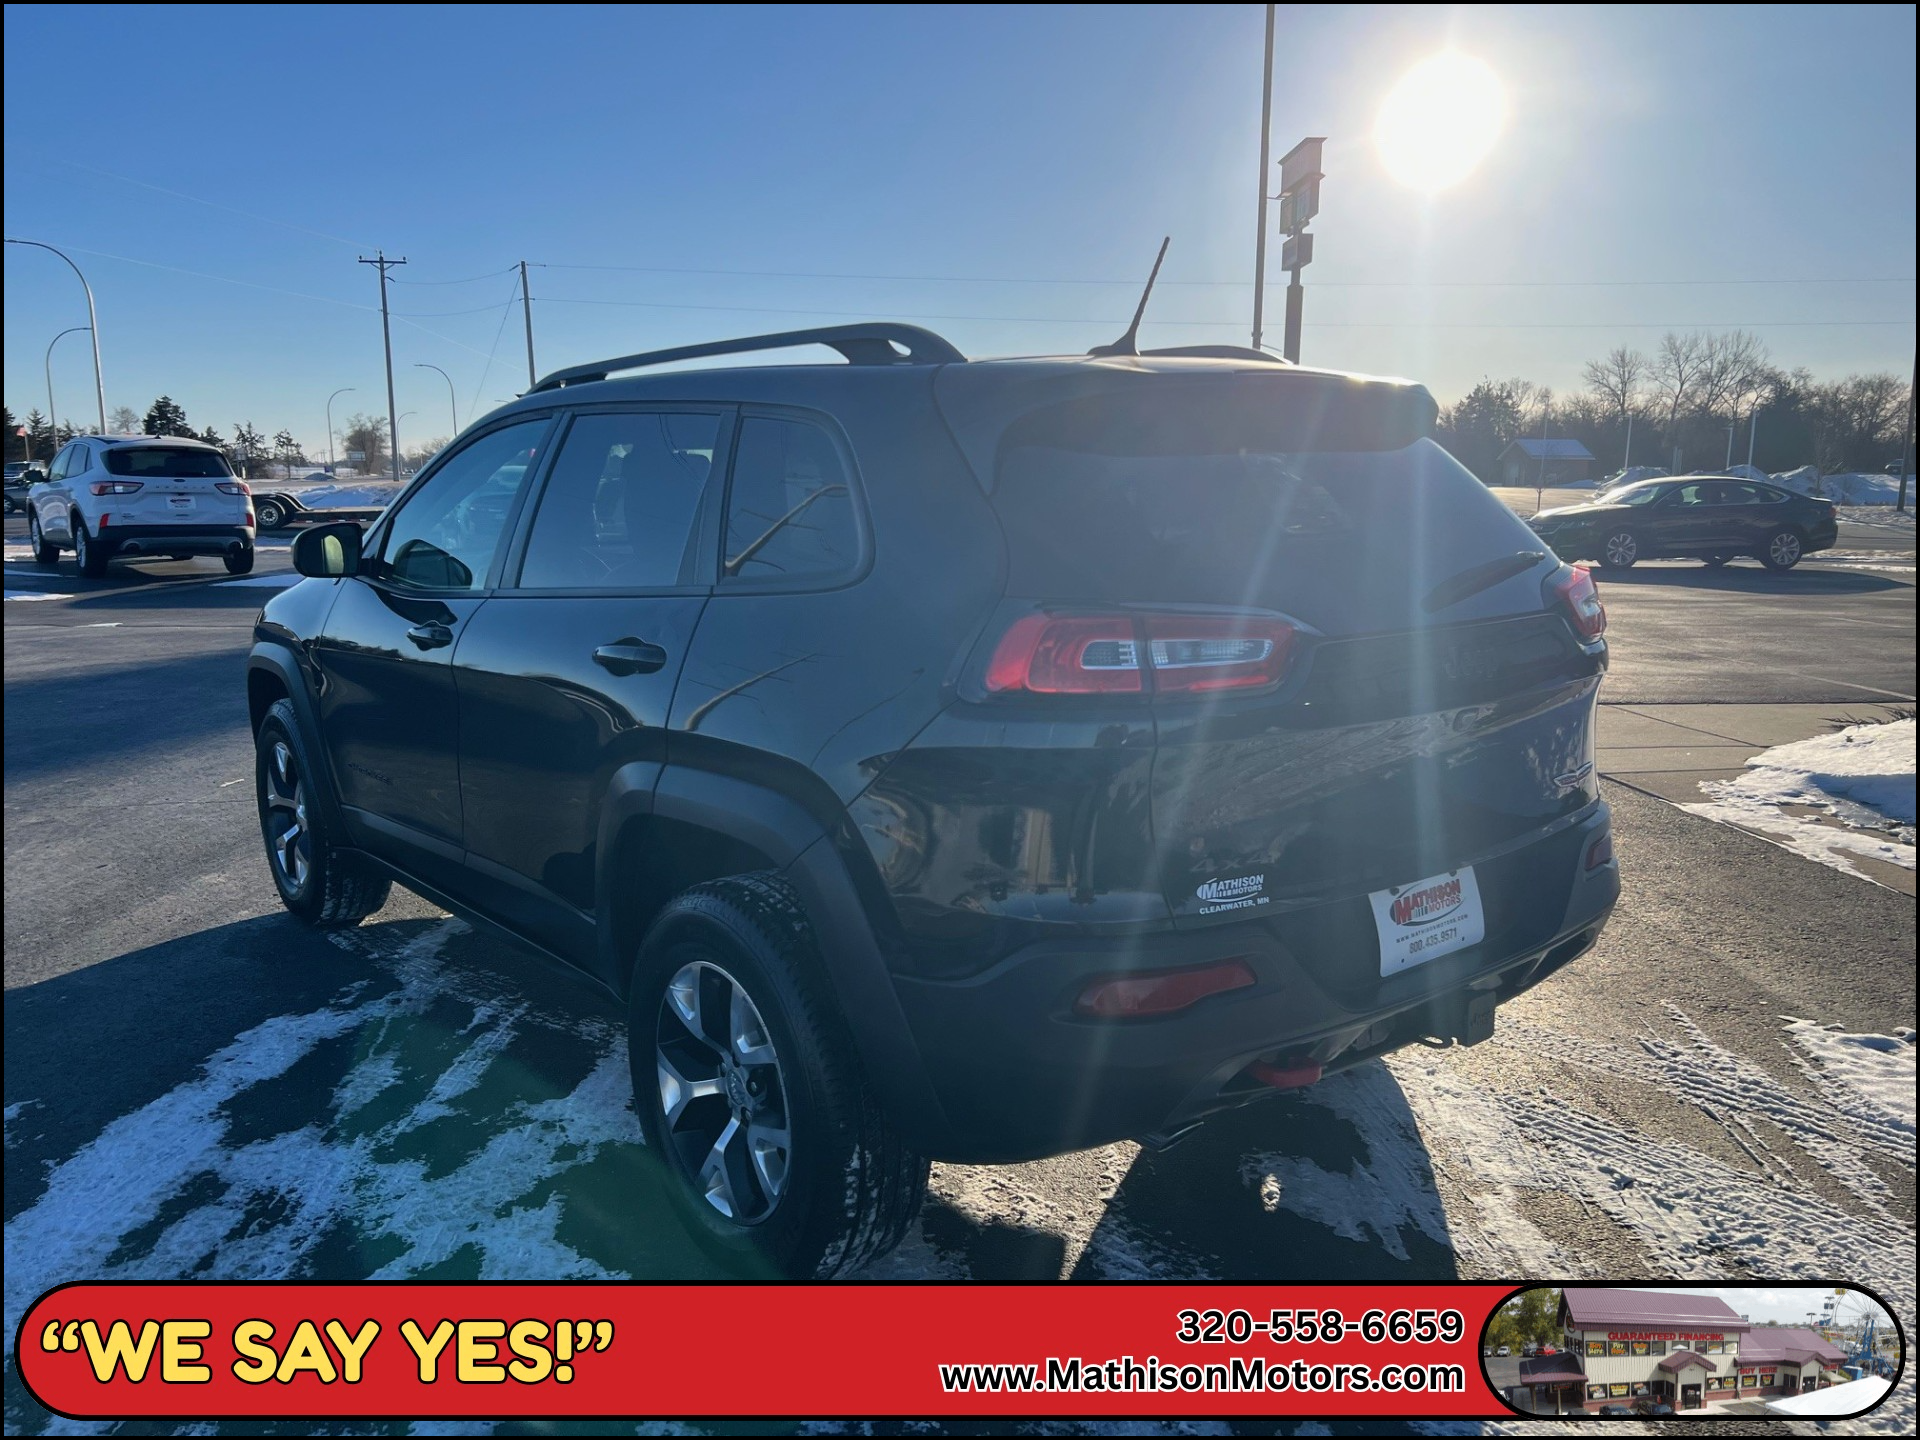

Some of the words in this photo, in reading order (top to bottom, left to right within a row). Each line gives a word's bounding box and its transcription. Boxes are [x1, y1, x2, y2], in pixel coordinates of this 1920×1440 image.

[1202, 874, 1264, 899] MATHISON
[1232, 884, 1263, 896] MOTORS
[1200, 899, 1256, 914] CLEARWATER,
[1257, 897, 1270, 905] MN
[1394, 879, 1461, 925] MATHISON
[1429, 895, 1461, 913] MOTORS
[1409, 927, 1458, 954] 800.435.9571
[1608, 1332, 1677, 1341] GUARANTEED
[1678, 1333, 1725, 1342] FINANCING
